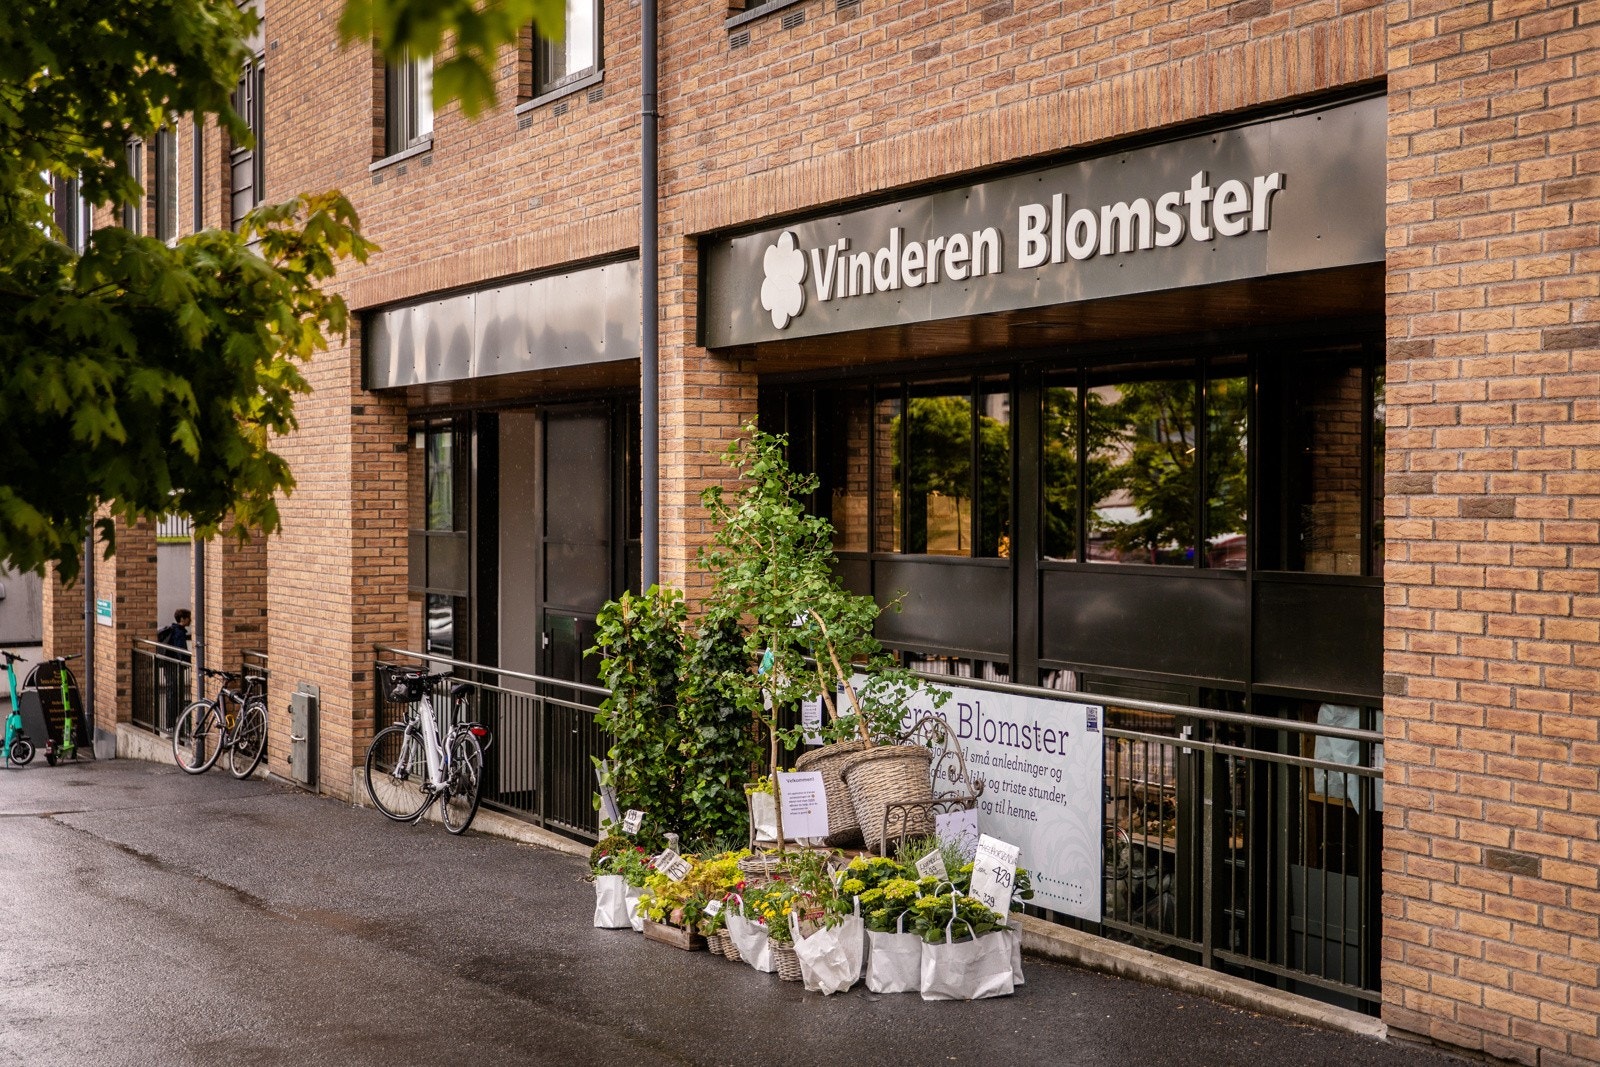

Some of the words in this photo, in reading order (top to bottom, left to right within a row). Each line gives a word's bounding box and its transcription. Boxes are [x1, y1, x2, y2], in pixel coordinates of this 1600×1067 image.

[811, 227, 1003, 302] Vinderen
[1018, 170, 1286, 270] Blomster
[957, 701, 1069, 756] Blomster
[970, 750, 990, 766] små
[991, 753, 1049, 779] anledninger
[1050, 767, 1063, 783] og
[988, 778, 1000, 794] og
[1002, 779, 1027, 796] triste
[1028, 785, 1067, 807] stunder,
[981, 800, 993, 815] og
[995, 799, 1006, 815] til
[1007, 800, 1038, 822] henne.
